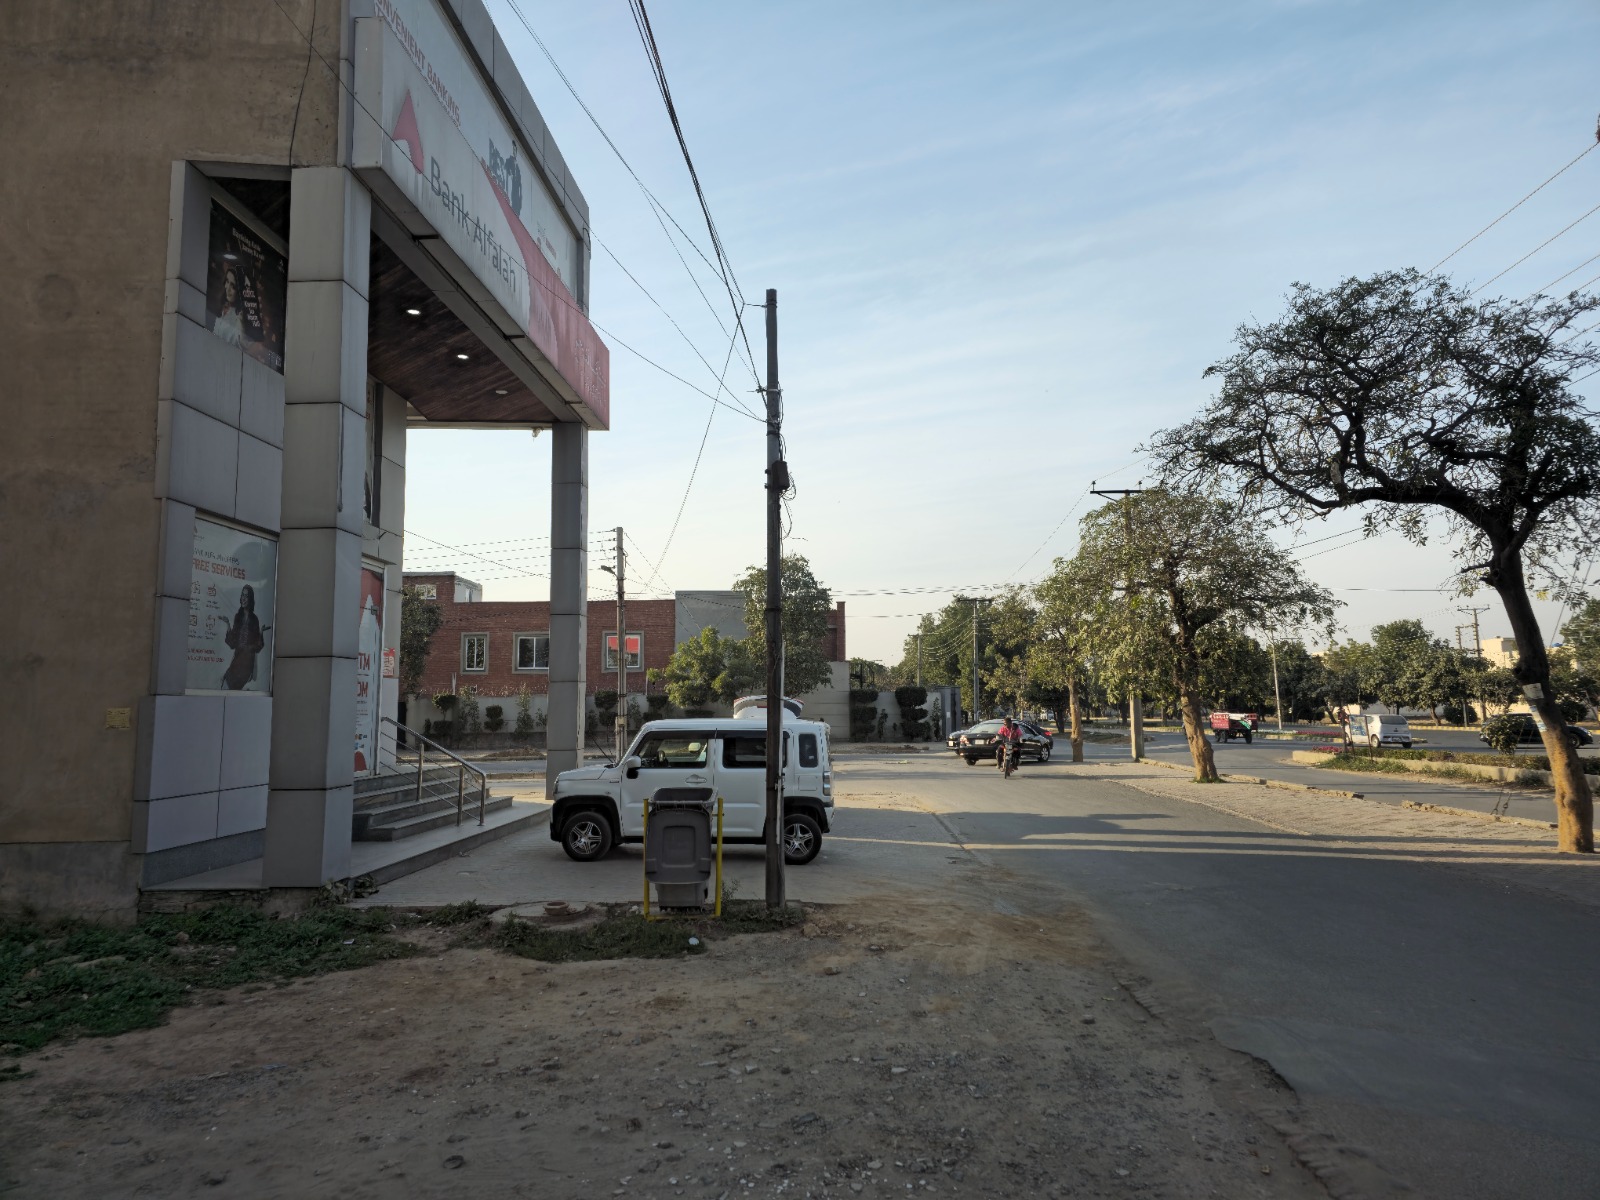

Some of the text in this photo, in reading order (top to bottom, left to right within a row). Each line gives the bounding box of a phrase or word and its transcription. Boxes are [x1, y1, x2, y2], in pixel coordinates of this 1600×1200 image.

[431, 156, 470, 237] Bank
[473, 216, 516, 293] Alfalah
[211, 562, 246, 580] SERVICES
[358, 652, 370, 671] TM
